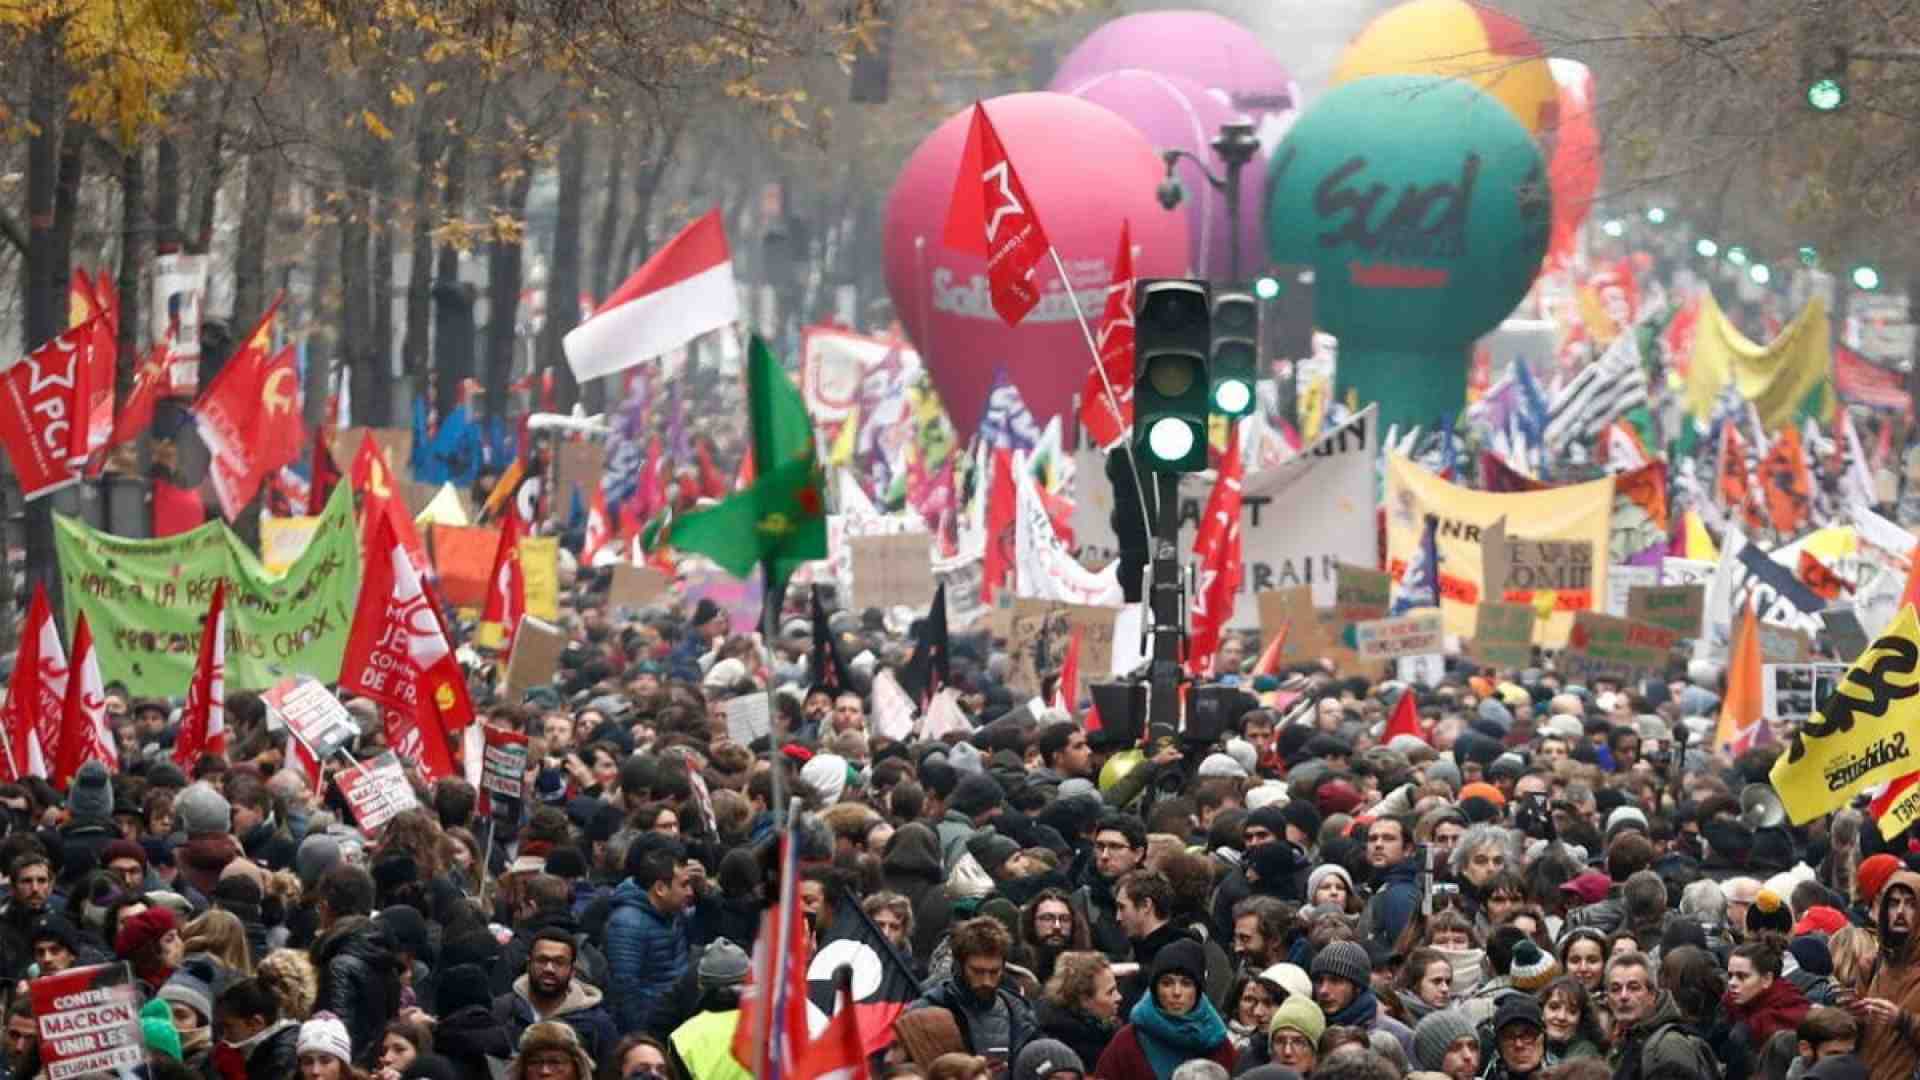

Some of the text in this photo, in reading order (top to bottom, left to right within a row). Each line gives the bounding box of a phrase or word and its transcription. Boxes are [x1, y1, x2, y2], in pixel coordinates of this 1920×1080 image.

[1313, 152, 1480, 248] Sud
[361, 667, 387, 691] DE
[53, 985, 113, 1010] CONTRE
[45, 1004, 129, 1034] MACRON
[54, 1027, 129, 1057] UNIR LES
